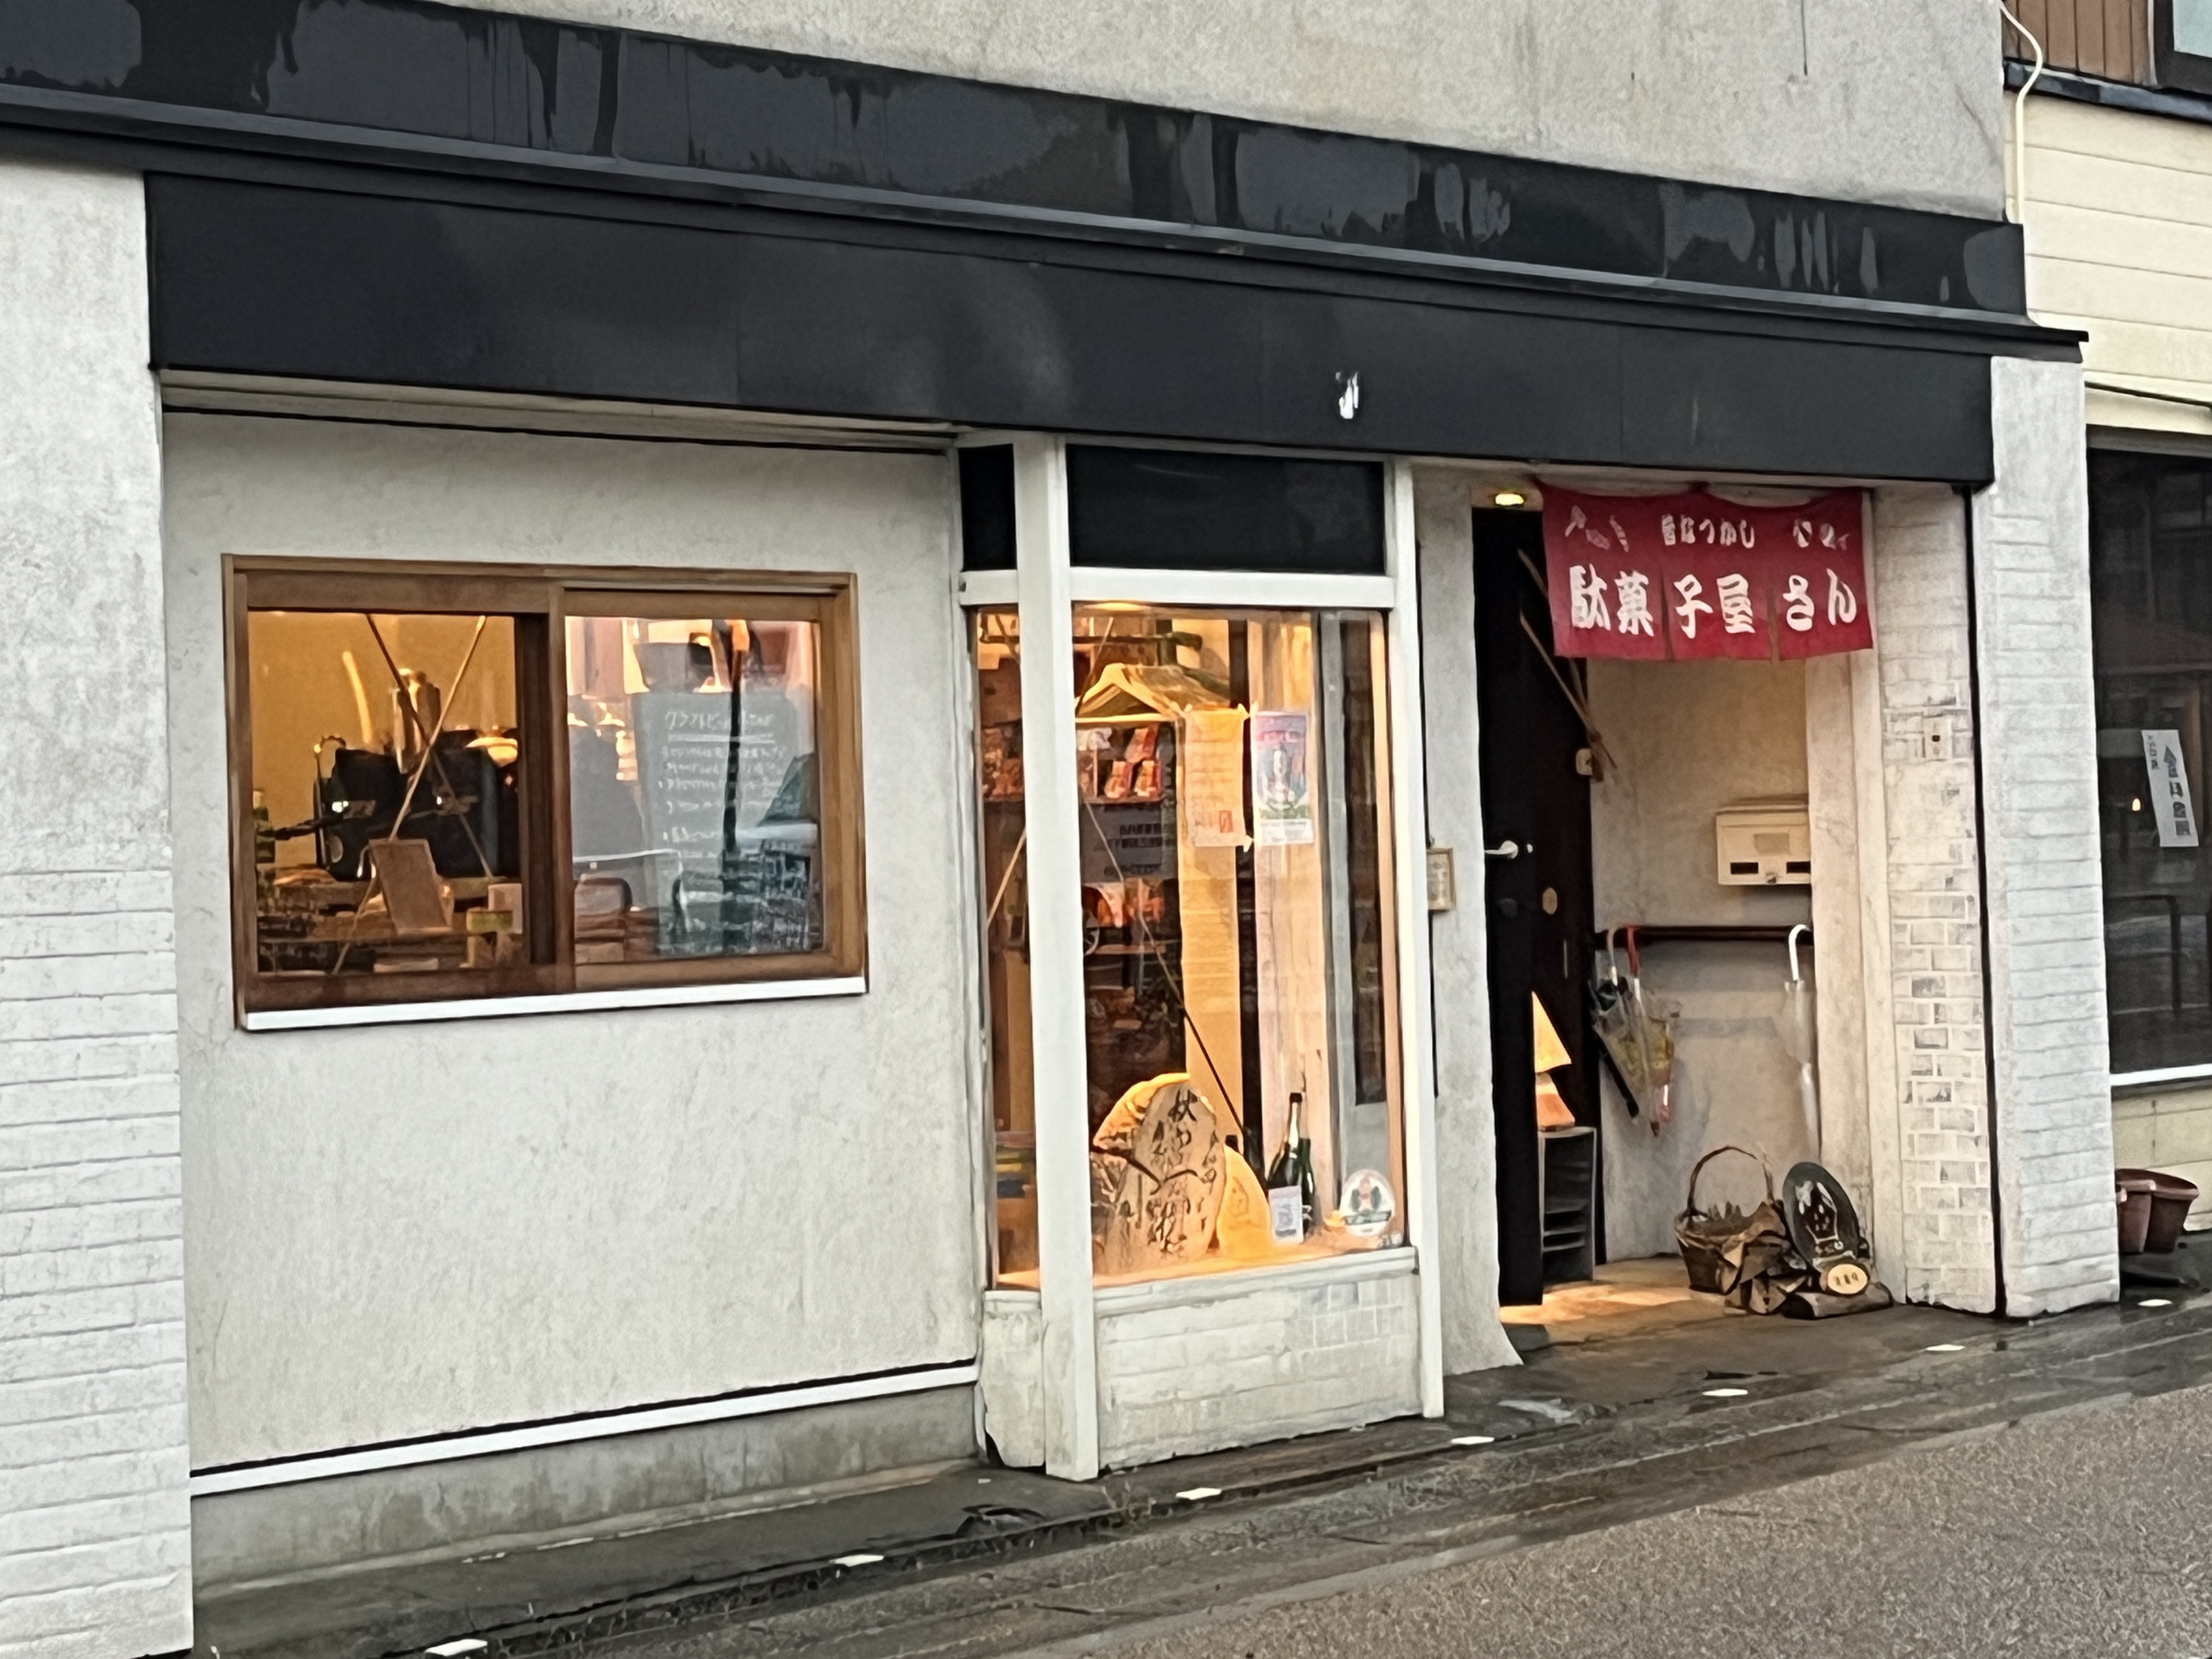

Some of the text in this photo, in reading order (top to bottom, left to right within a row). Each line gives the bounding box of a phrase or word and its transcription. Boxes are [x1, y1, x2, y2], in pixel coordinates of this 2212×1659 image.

[1570, 563, 1857, 639] 駄菓子屋さん
